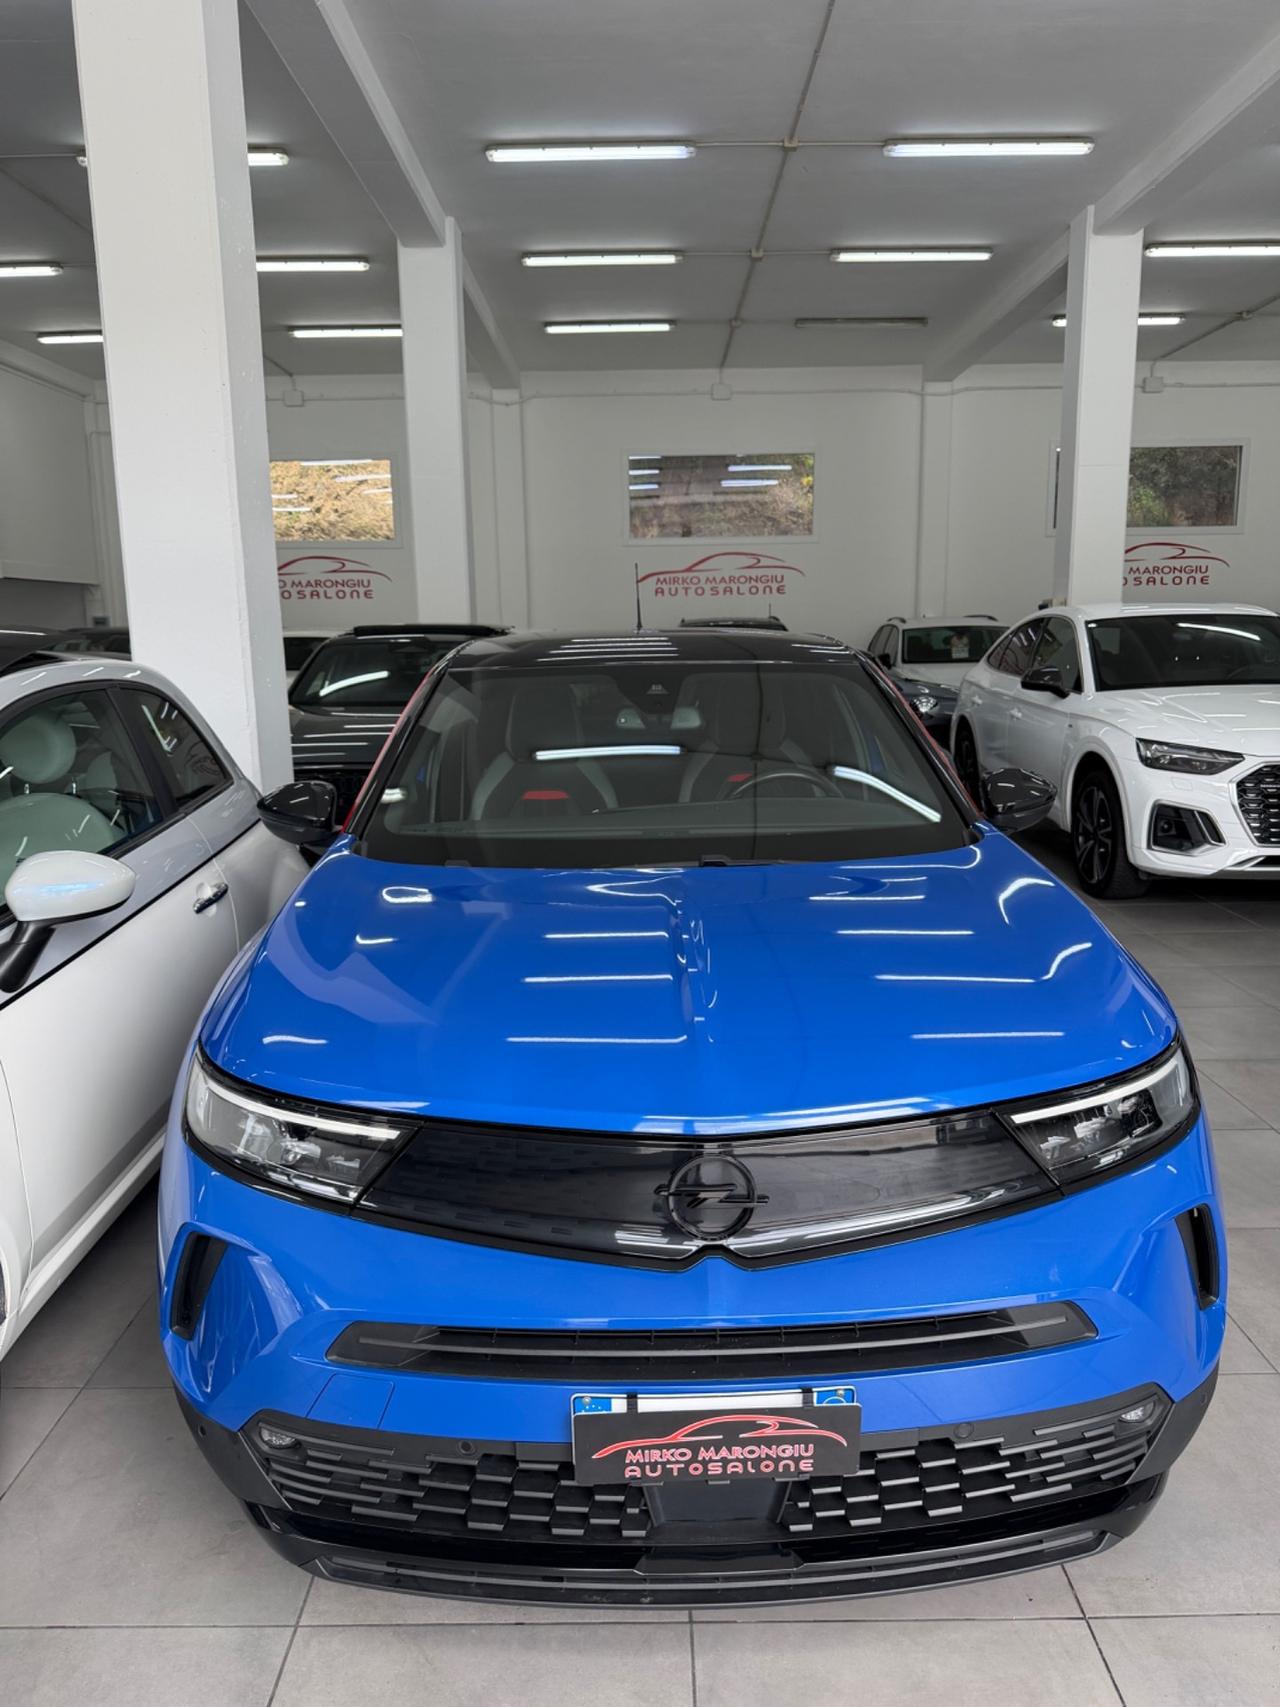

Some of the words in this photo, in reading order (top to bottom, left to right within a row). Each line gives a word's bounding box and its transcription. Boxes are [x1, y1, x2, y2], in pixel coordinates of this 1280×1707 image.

[1128, 565, 1208, 575] MARONGIU
[290, 579, 370, 589] MARONGIU
[655, 576, 700, 585] MIRKO
[704, 574, 785, 585] MARONGIU
[280, 589, 374, 600] OSALONE
[654, 585, 787, 597] AUTOSALONE
[625, 1447, 692, 1464] MIRKO
[697, 1443, 814, 1461] MARONGIU
[624, 1459, 814, 1478] AUTOSALONE
